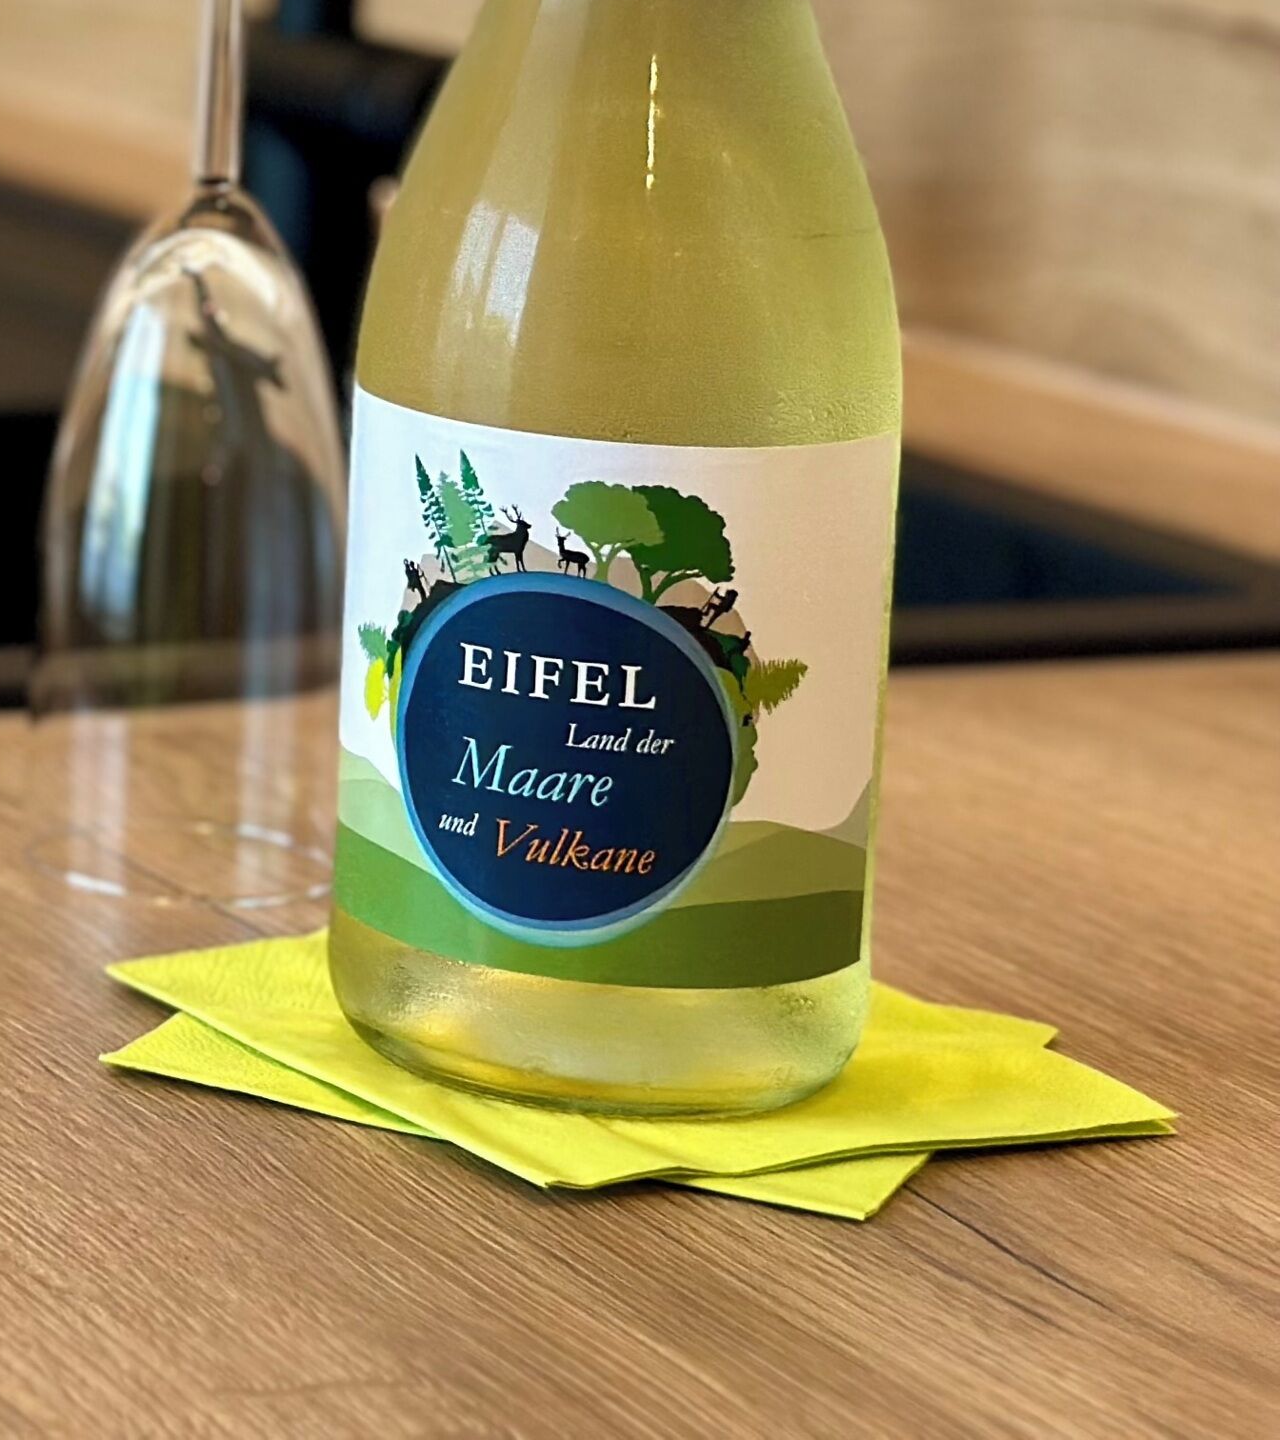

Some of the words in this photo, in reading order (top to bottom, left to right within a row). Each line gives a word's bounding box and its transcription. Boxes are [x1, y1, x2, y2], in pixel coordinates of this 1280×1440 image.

[458, 642, 656, 709] EIFEL
[452, 736, 613, 807] Maare
[566, 723, 631, 755] Land
[636, 727, 675, 756] der
[439, 812, 479, 837] und
[495, 818, 656, 874] Vulkane
